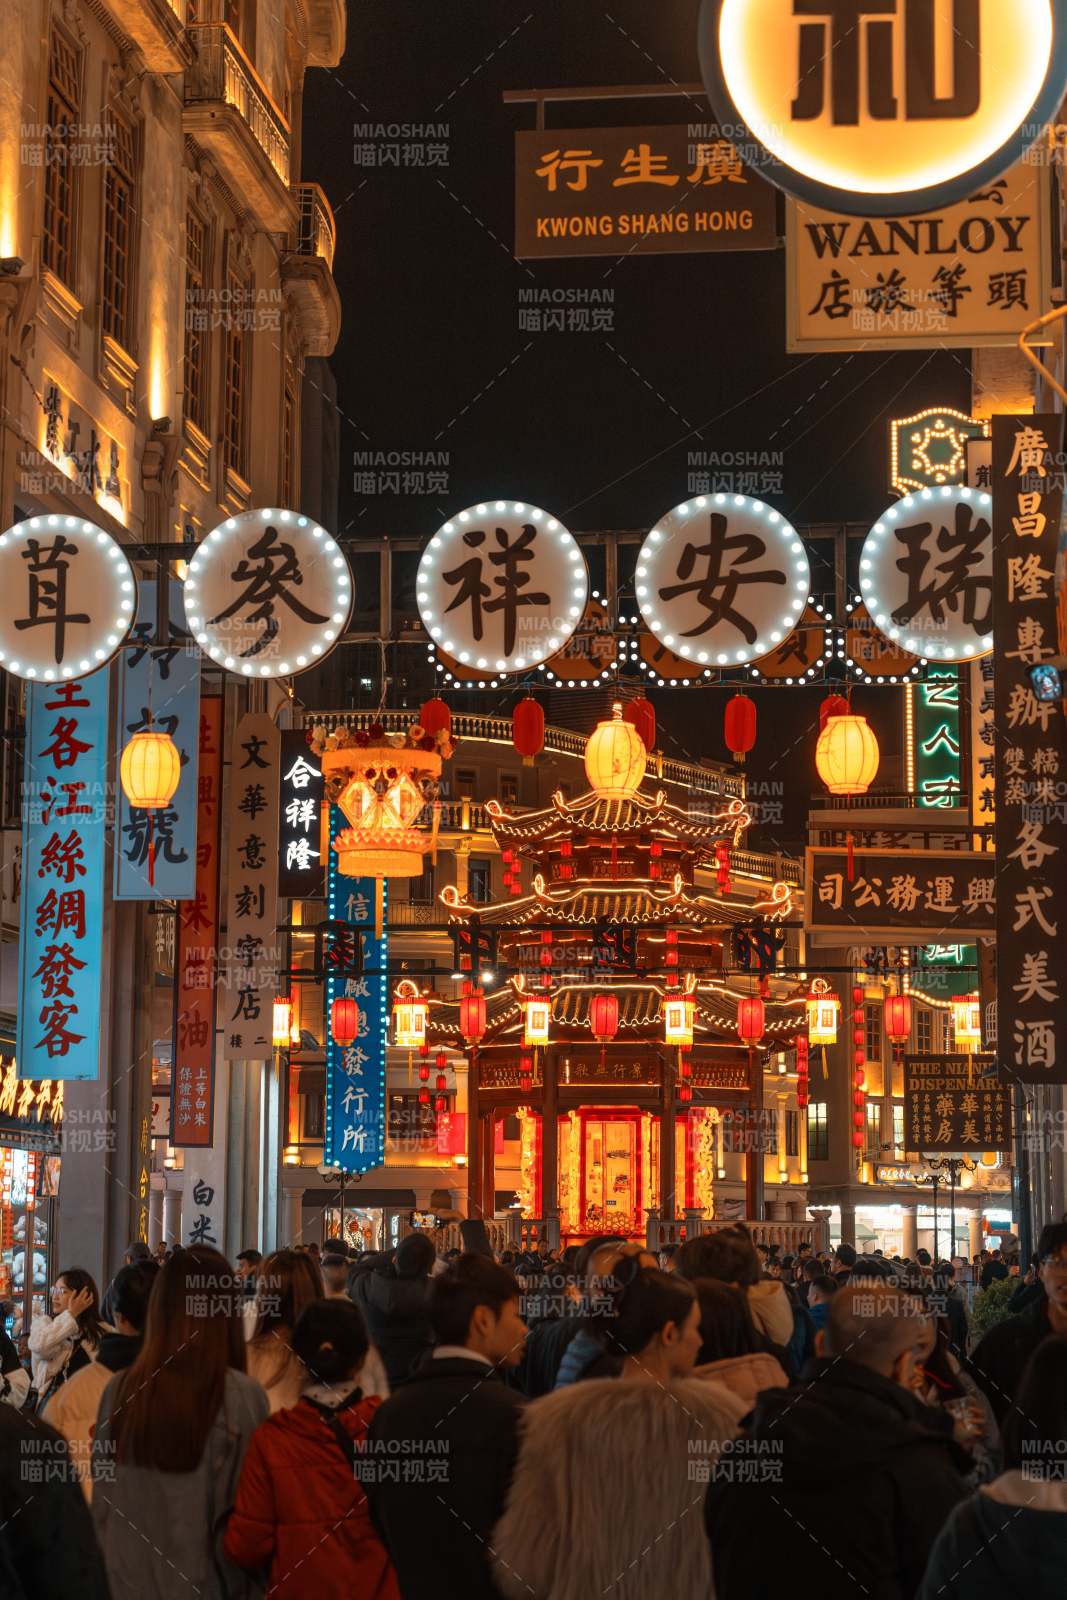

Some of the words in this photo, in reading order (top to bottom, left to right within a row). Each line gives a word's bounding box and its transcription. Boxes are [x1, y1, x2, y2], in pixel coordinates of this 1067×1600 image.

[536, 215, 613, 238] KWONG
[618, 212, 689, 236] SHANG
[695, 210, 754, 232] HONG
[805, 216, 1031, 260] WANLOY
[283, 755, 322, 871] 合祥隆
[909, 1062, 940, 1075] THE
